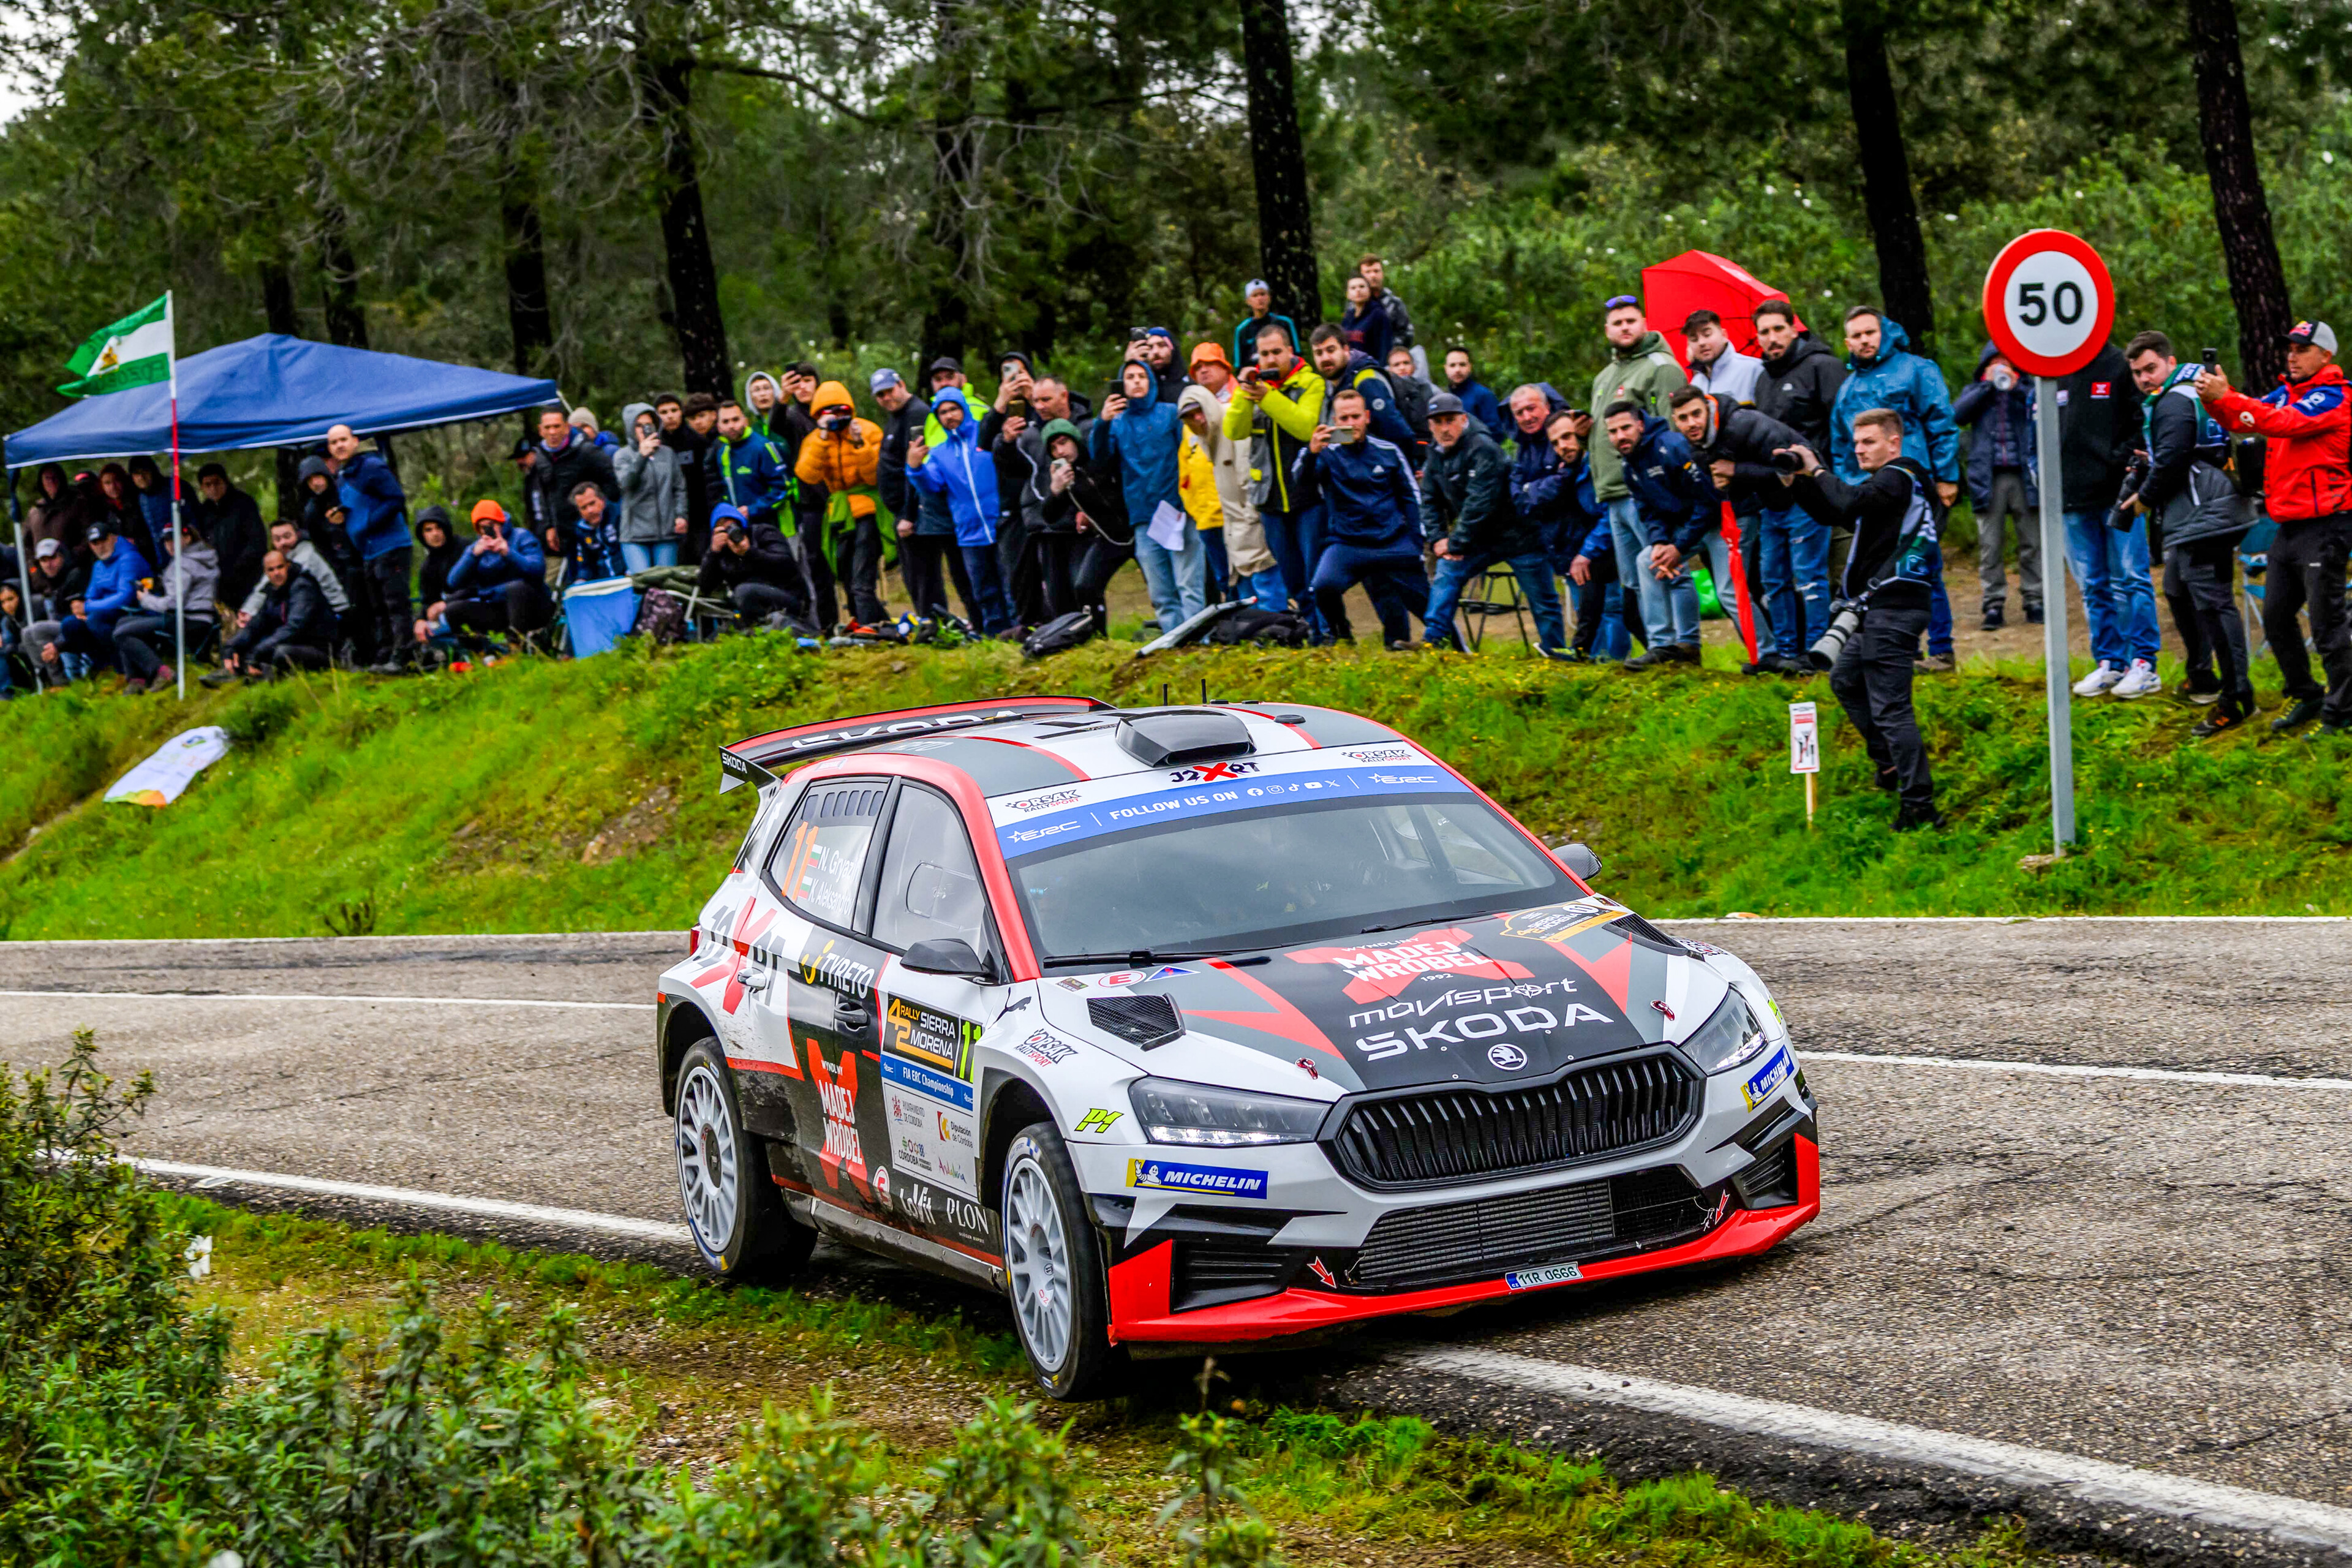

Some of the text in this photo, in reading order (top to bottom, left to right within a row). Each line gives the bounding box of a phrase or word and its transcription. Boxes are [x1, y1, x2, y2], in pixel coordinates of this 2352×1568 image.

[2019, 281, 2084, 327] 50
[1348, 749, 1412, 760] ORSAK
[1169, 761, 1261, 782] J2XRT
[1012, 790, 1082, 810] ORSAK
[1109, 791, 1238, 820] FOLLOW US ON
[782, 821, 819, 902] 11
[818, 846, 860, 883] N. Gryazin
[1333, 941, 1462, 969] MADEJ
[820, 952, 875, 999] TYRETO
[1420, 973, 1453, 982] 1992
[900, 1005, 920, 1020] RALLY
[920, 1012, 956, 1038] SIERRA
[910, 1029, 953, 1059] MORENA
[1023, 1031, 1079, 1065] ORSAK
[912, 1070, 921, 1084] ERC
[922, 1074, 954, 1098] Championship
[1760, 1055, 1789, 1091] MICHELIN
[819, 1079, 855, 1125] MADEJ
[1074, 1108, 1125, 1133] P1
[823, 1117, 862, 1165] WRÓBEL
[1164, 1171, 1262, 1190] MICHELIN
[947, 1197, 989, 1235] PLON
[1518, 1272, 1543, 1285] 11R
[1545, 1266, 1577, 1281] 0666
